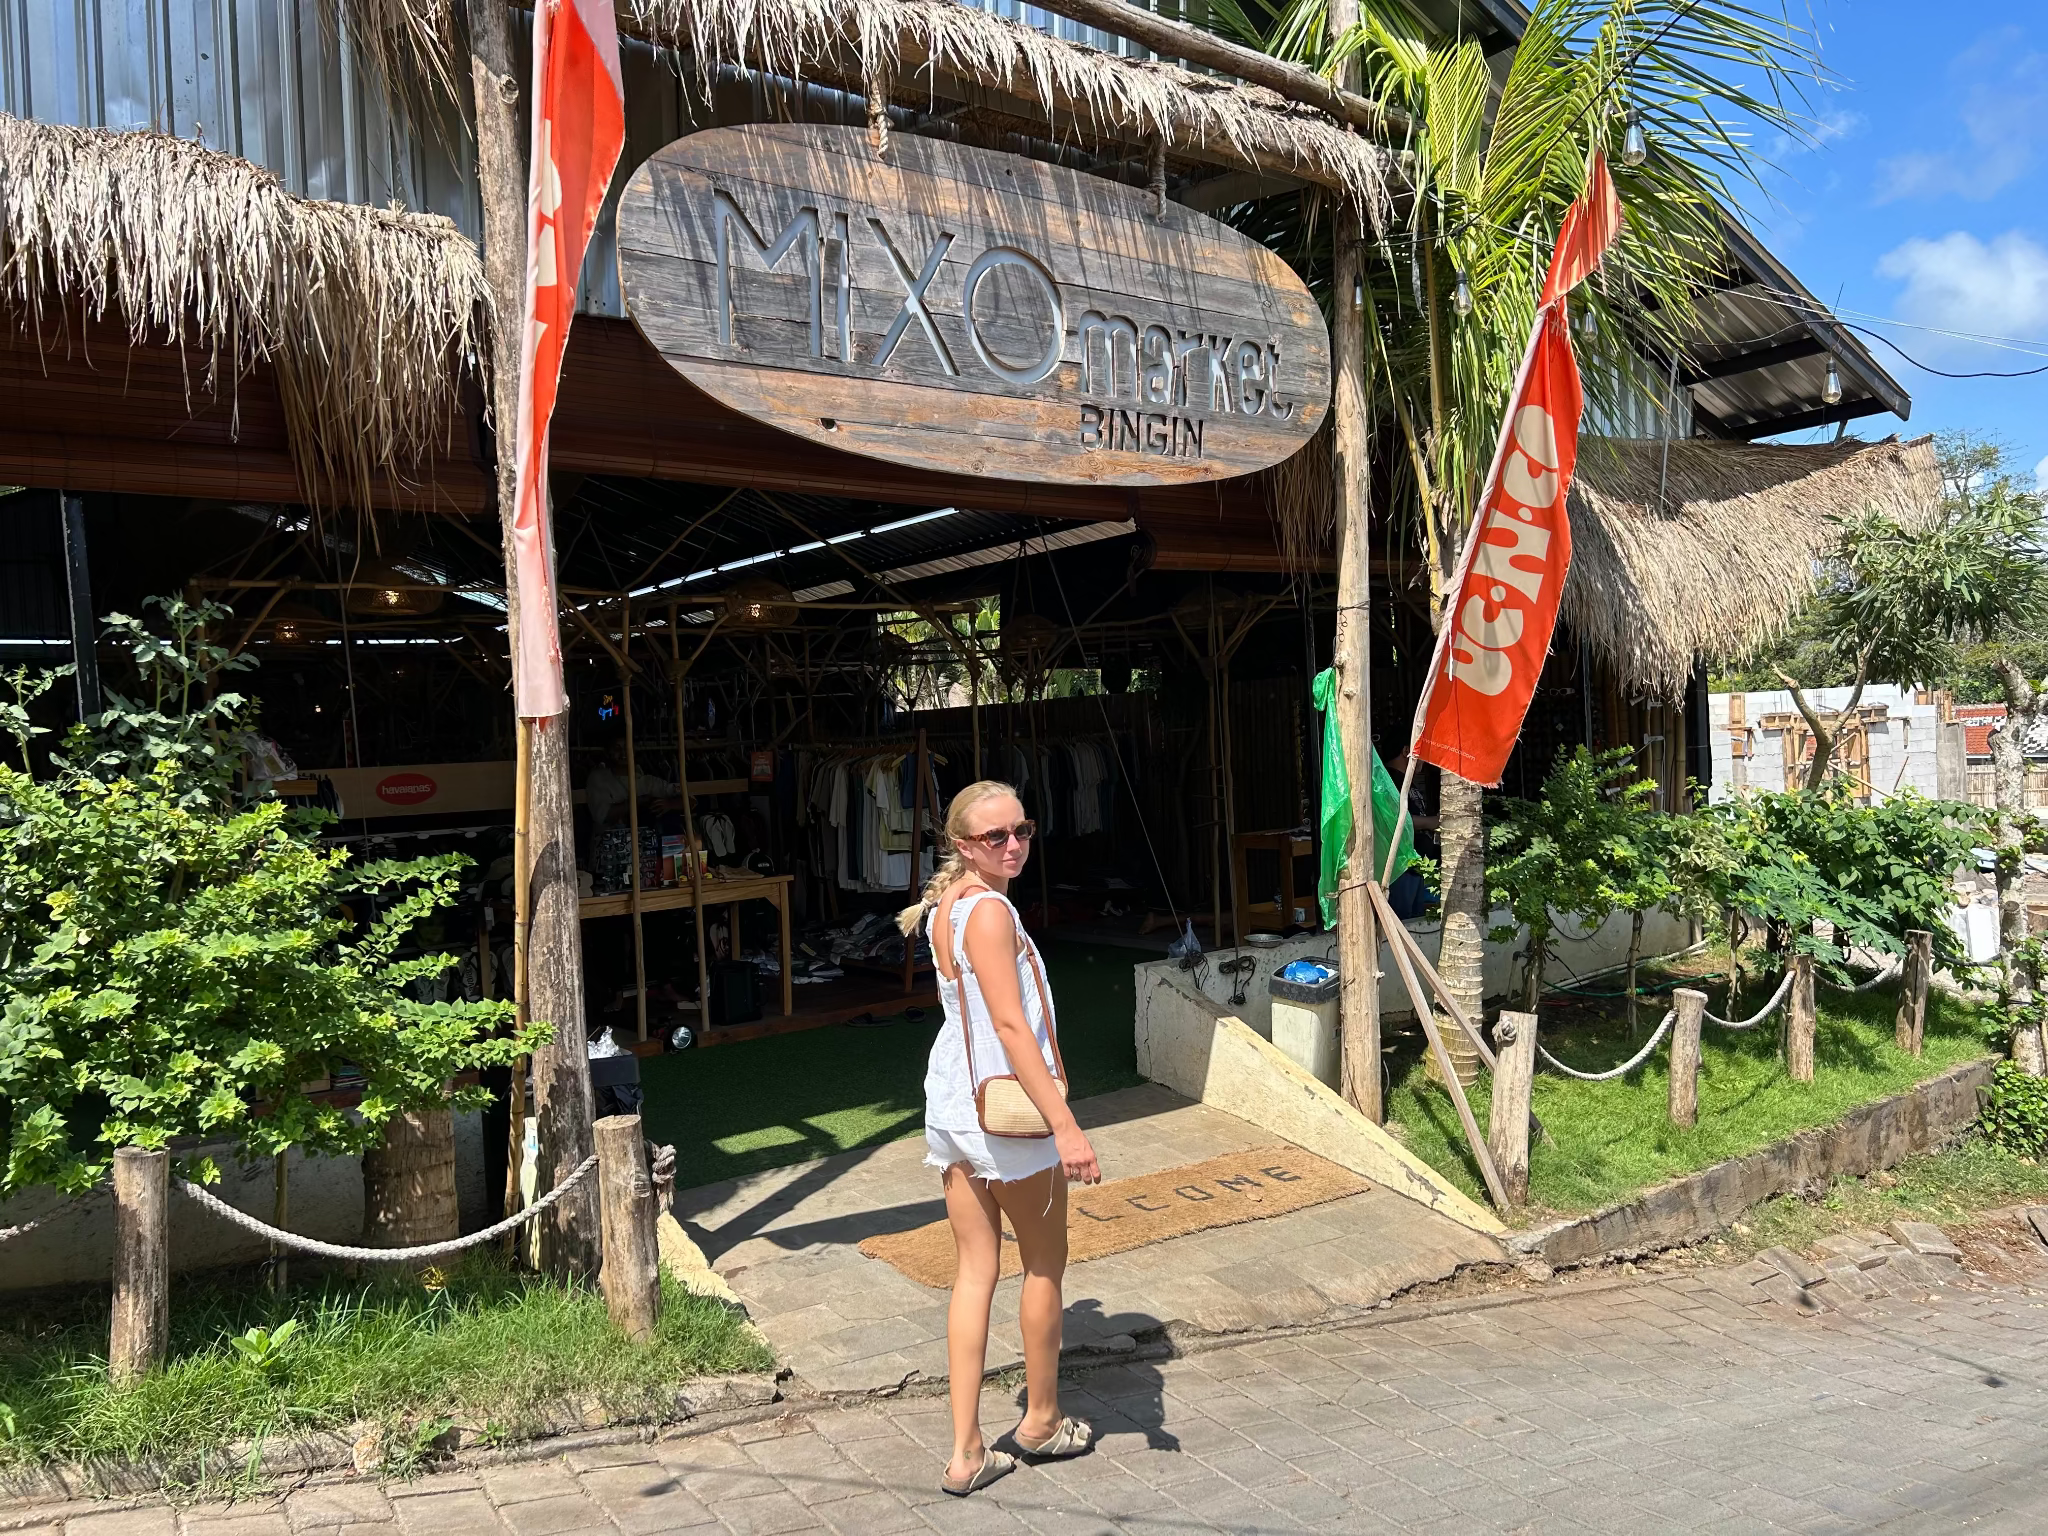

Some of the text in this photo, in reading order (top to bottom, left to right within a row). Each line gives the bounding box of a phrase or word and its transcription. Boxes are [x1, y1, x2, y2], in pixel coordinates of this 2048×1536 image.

[713, 187, 1066, 384] MIXO
[1079, 309, 1294, 421] market
[1080, 403, 1204, 459] BINGIN
